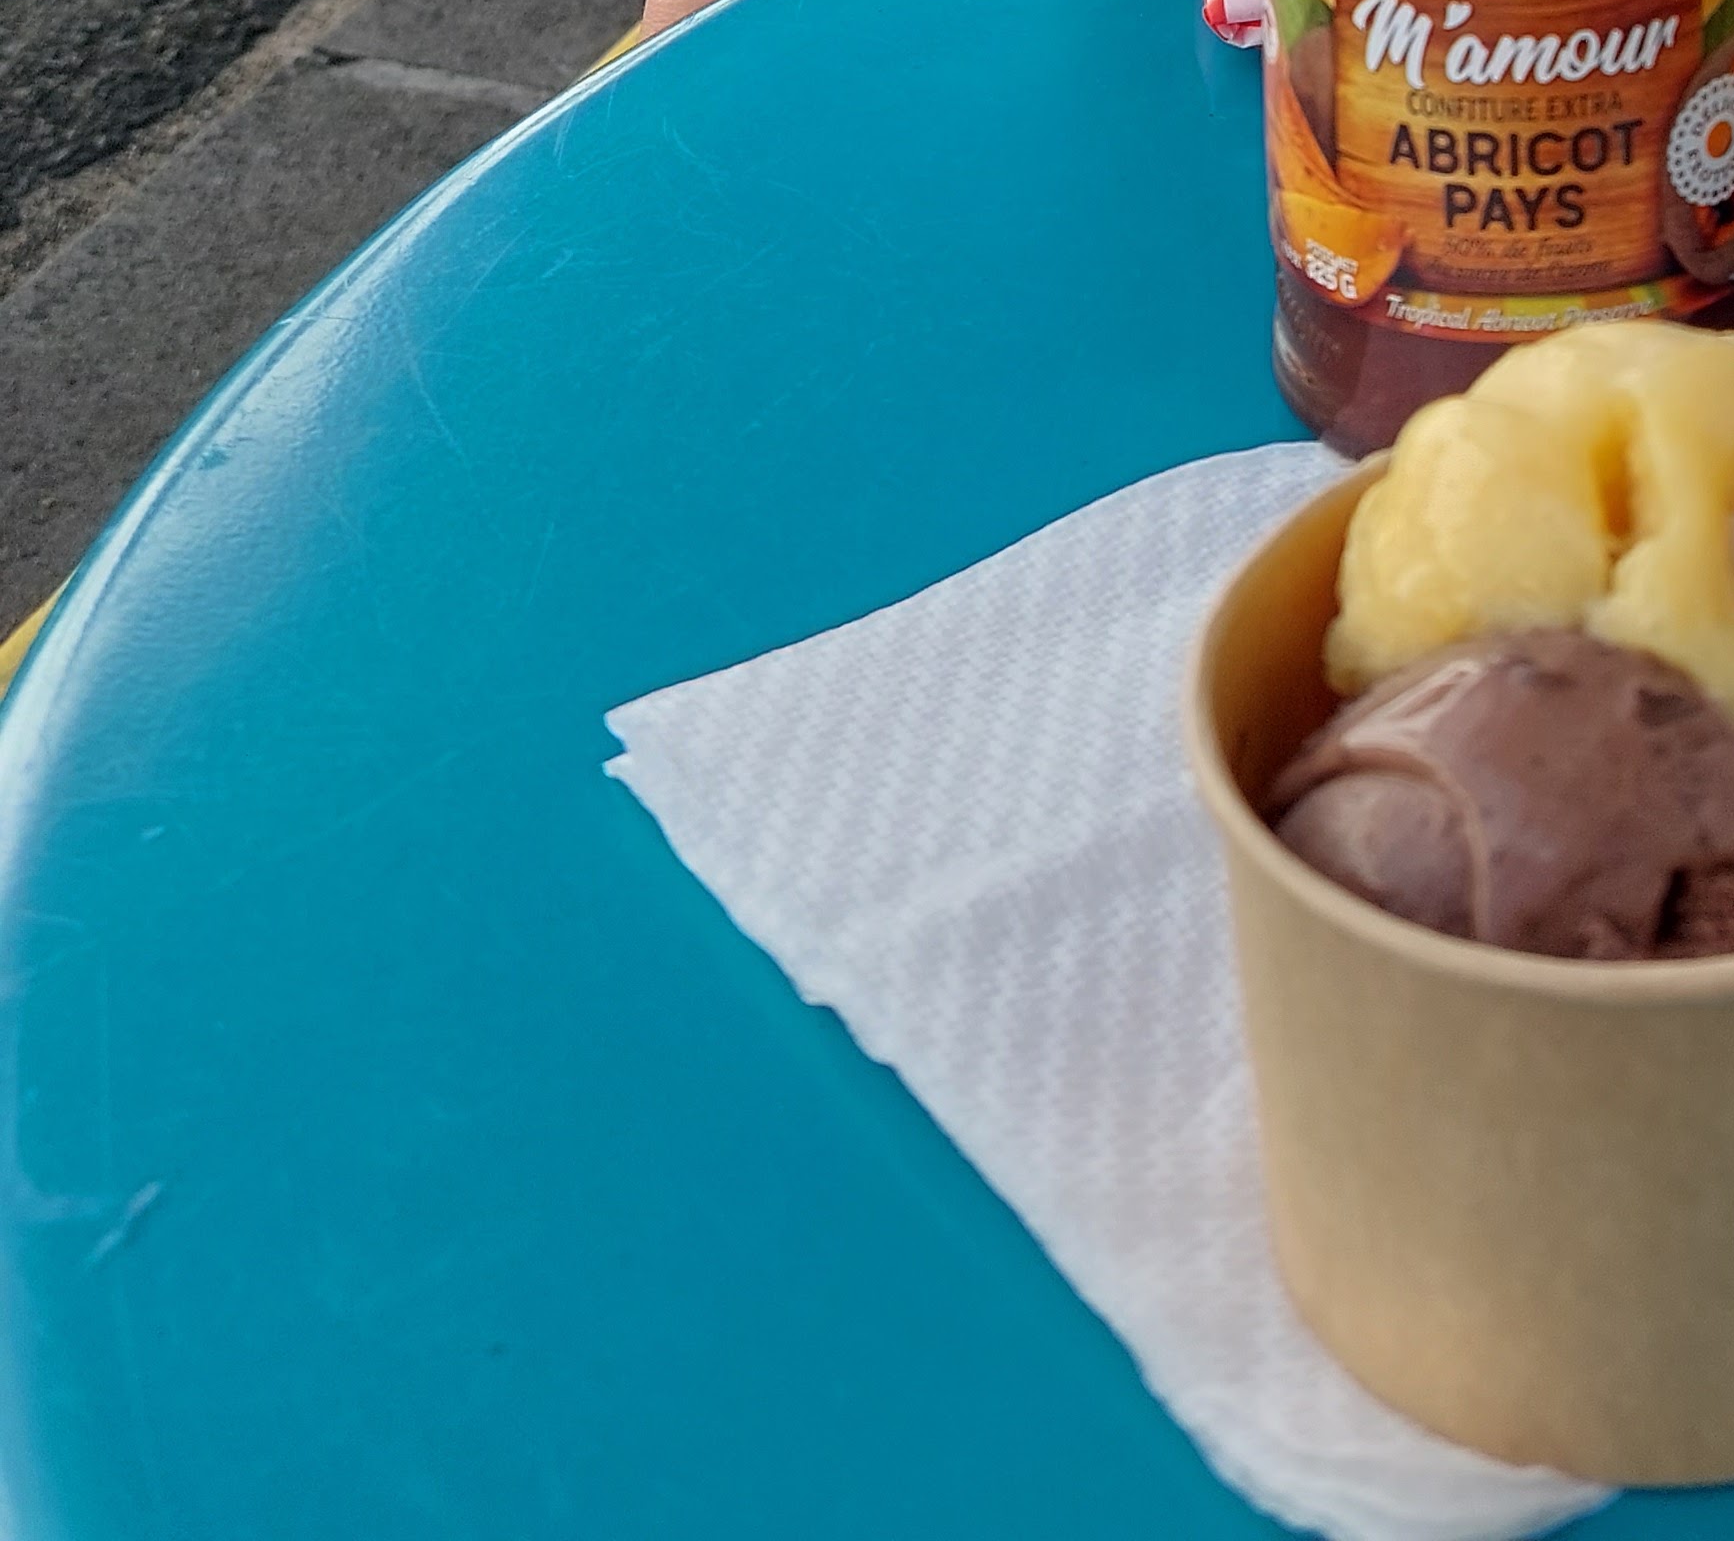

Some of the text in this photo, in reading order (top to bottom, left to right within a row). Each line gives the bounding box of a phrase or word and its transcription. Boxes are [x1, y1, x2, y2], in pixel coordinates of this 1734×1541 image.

[1405, 89, 1624, 123] CONFITURE EXTRA
[1389, 120, 1645, 177] ABRICOT
[1446, 184, 1587, 231] PAYS
[1386, 294, 1471, 330] Tropical
